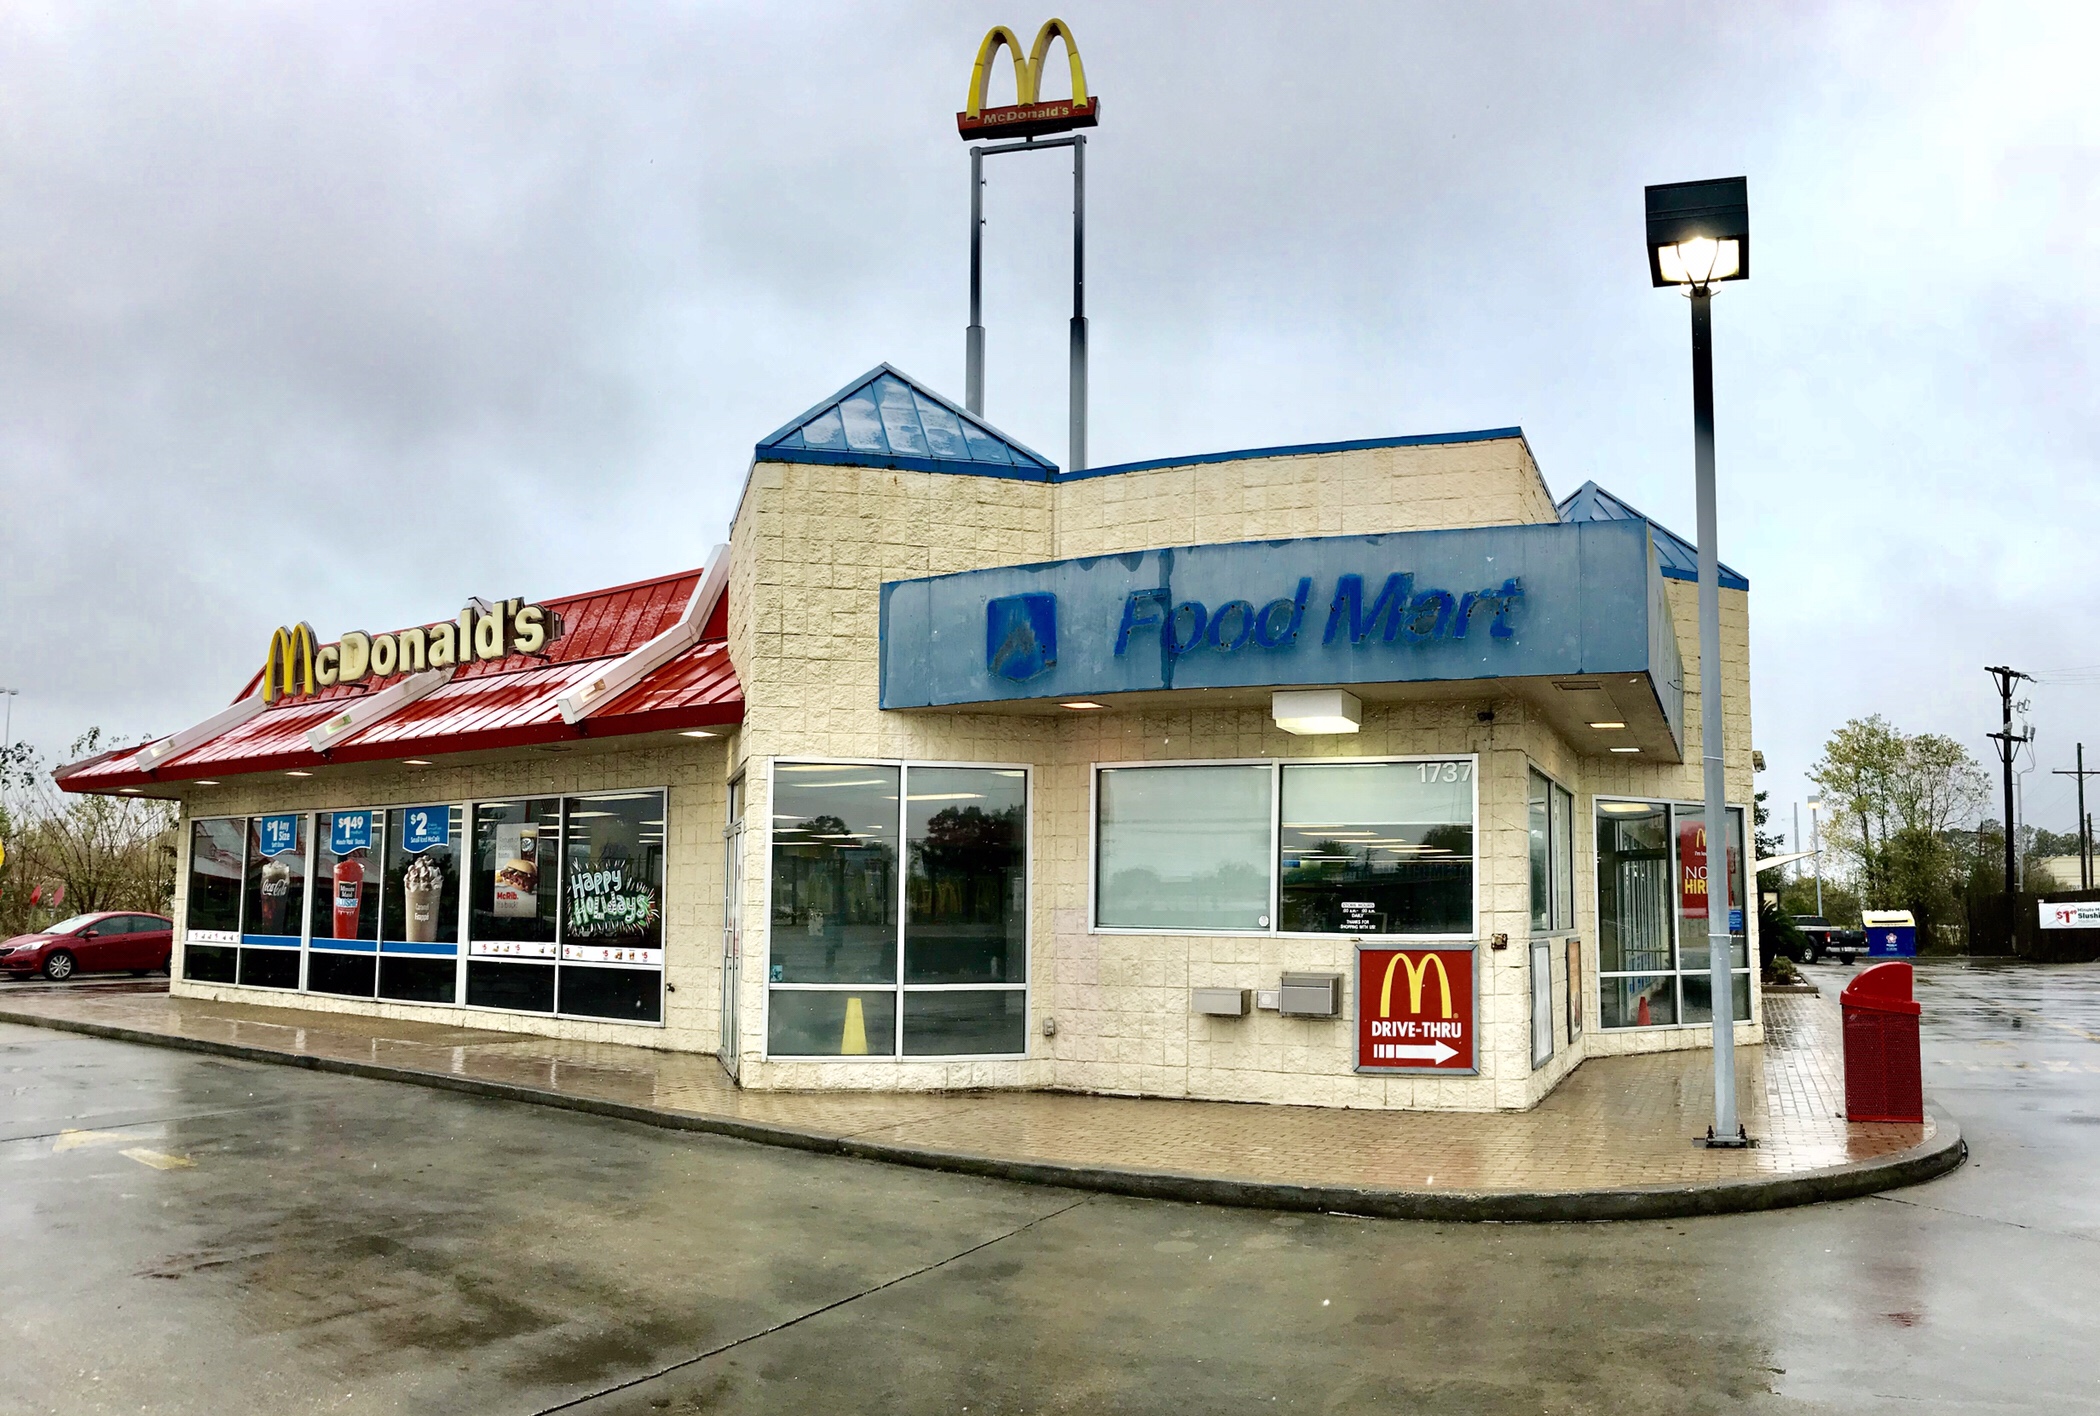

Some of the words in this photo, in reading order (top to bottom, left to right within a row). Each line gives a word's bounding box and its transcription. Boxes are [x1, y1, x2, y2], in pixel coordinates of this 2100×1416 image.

[983, 106, 1070, 125] McDonald's
[1113, 577, 1312, 656] Food
[1322, 572, 1525, 645] Mart
[263, 596, 548, 705] McDonald's
[1416, 762, 1472, 783] 1737
[266, 820, 279, 841] $1
[410, 812, 428, 836] $2
[1685, 865, 1708, 880] NO
[571, 869, 622, 899] Happy
[1684, 879, 1709, 894] HIR
[1371, 1021, 1462, 1038] DRIVE-THRU
